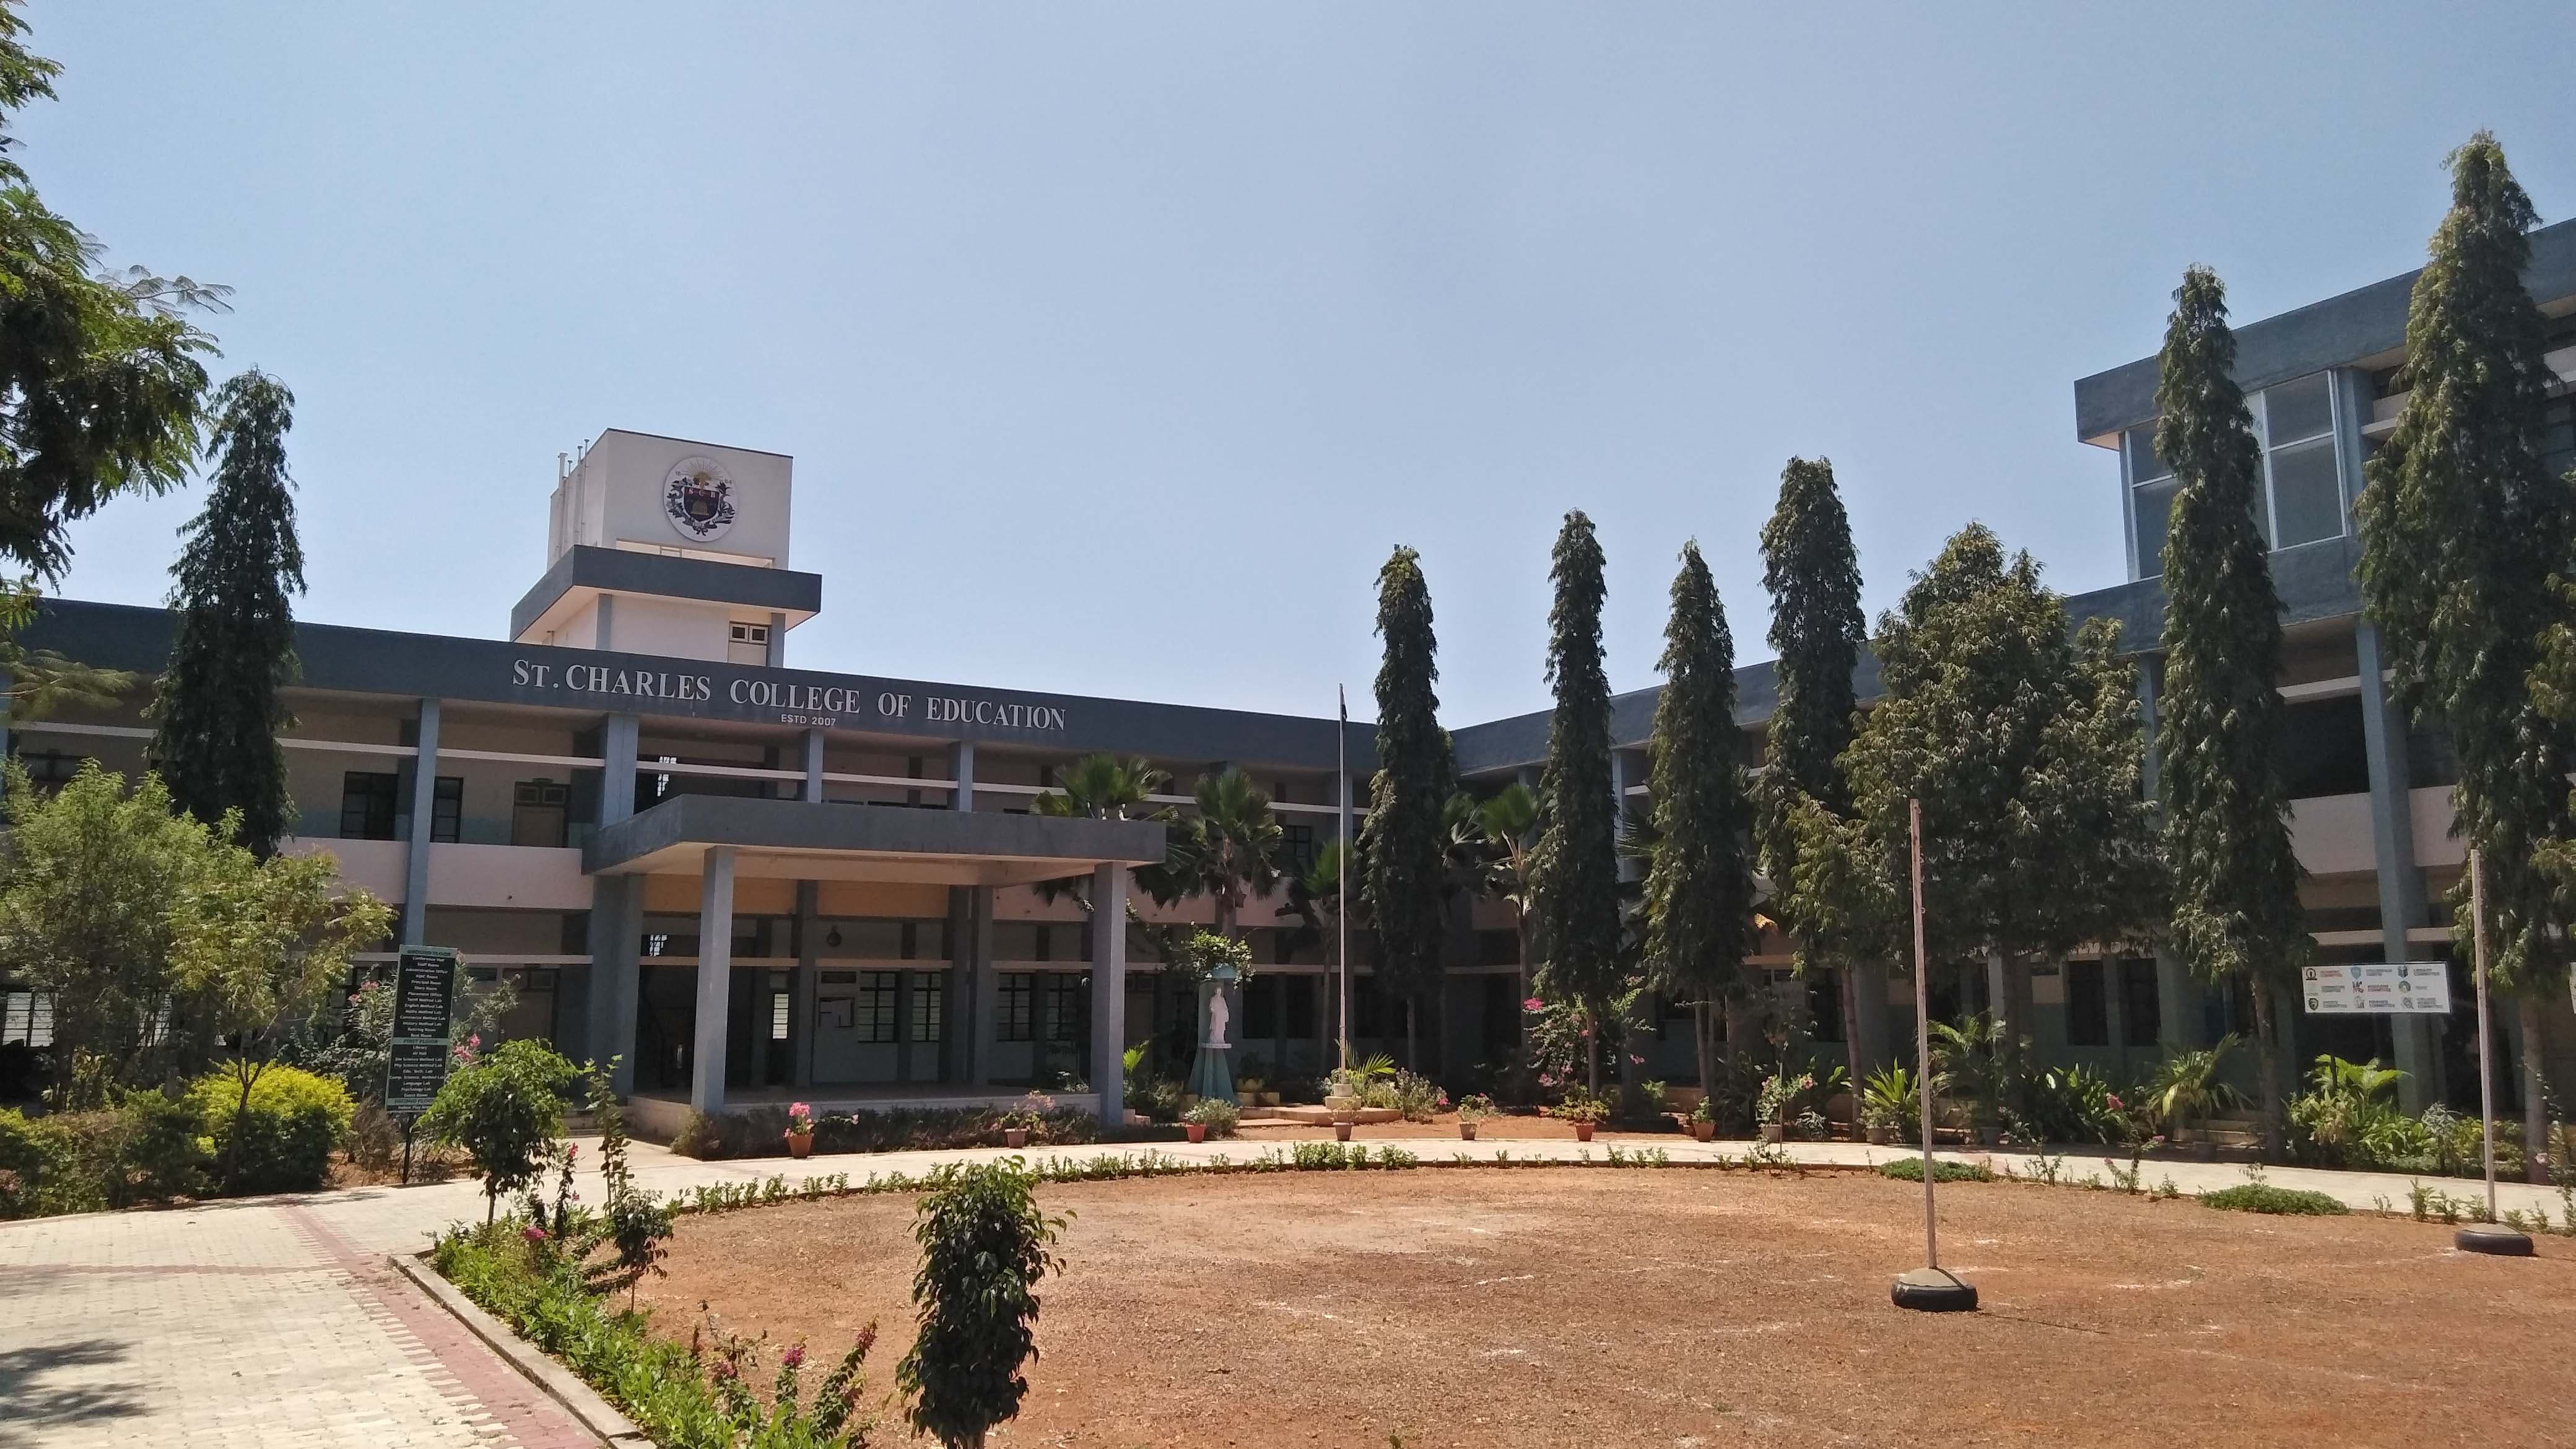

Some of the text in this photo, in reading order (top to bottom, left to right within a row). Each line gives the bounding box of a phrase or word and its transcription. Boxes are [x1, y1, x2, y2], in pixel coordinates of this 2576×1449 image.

[565, 664, 711, 701] CHARLES
[730, 679, 861, 714] COLLEGE
[877, 692, 912, 718] OF
[926, 696, 1066, 731] EDUCATION
[781, 713, 837, 726] ESTD 2007
